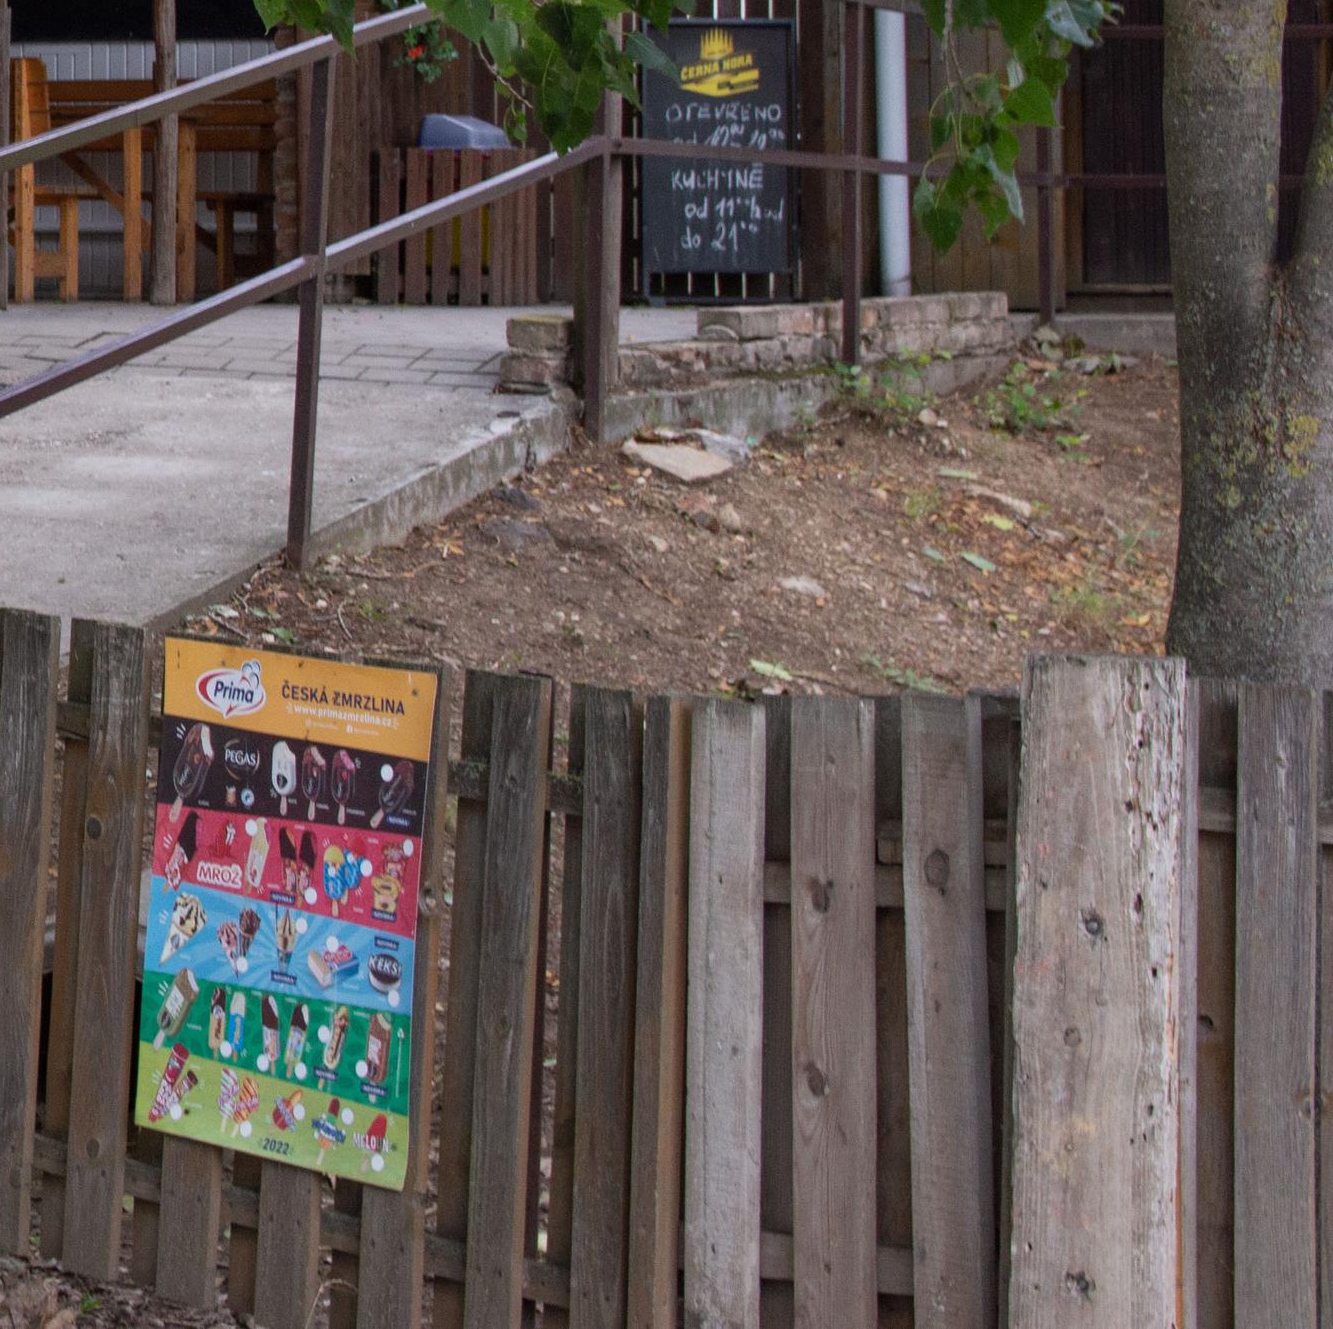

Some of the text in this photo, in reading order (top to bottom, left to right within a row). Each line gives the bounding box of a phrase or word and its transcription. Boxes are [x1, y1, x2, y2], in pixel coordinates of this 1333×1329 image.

[684, 196, 709, 220] od
[680, 225, 702, 249] do
[213, 679, 405, 716] Prima ČESKÁ ZMRZLINA
[224, 748, 257, 766] PEGAS
[262, 1138, 290, 1155] 2022
